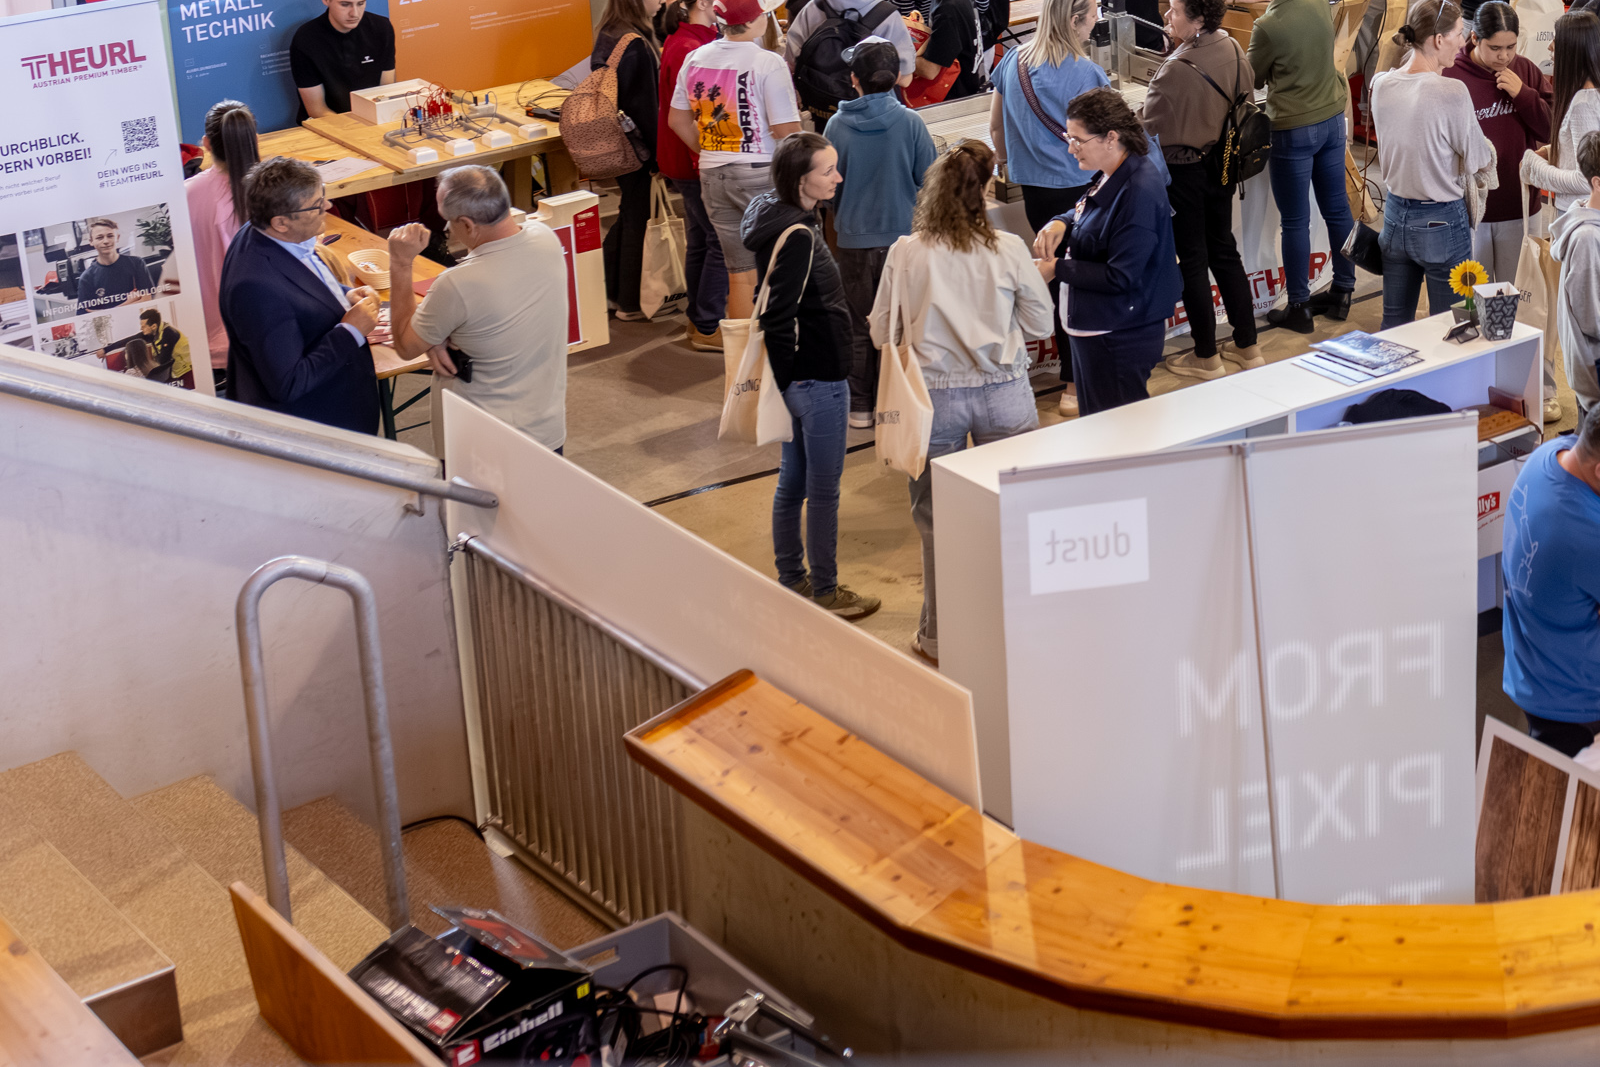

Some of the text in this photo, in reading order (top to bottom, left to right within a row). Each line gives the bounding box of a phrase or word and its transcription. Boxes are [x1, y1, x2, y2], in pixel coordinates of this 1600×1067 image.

[181, 11, 275, 44] TECHNIK
[21, 39, 147, 81] THEURL
[33, 78, 71, 89] AUSTRIAN
[73, 71, 108, 83] PREMIUM
[0, 132, 85, 156] URCHBLICK.
[36, 147, 92, 167] VORBEI!
[44, 174, 61, 183] Beruf
[97, 161, 157, 179] DEIN WEG INS
[99, 170, 164, 189] #TEAMTHEURL
[15, 189, 33, 197] vorbei
[33, 186, 45, 194] und
[42, 283, 172, 318] INFORMATIONSTECHNOLOGIE
[483, 1000, 563, 1053] Einhell
